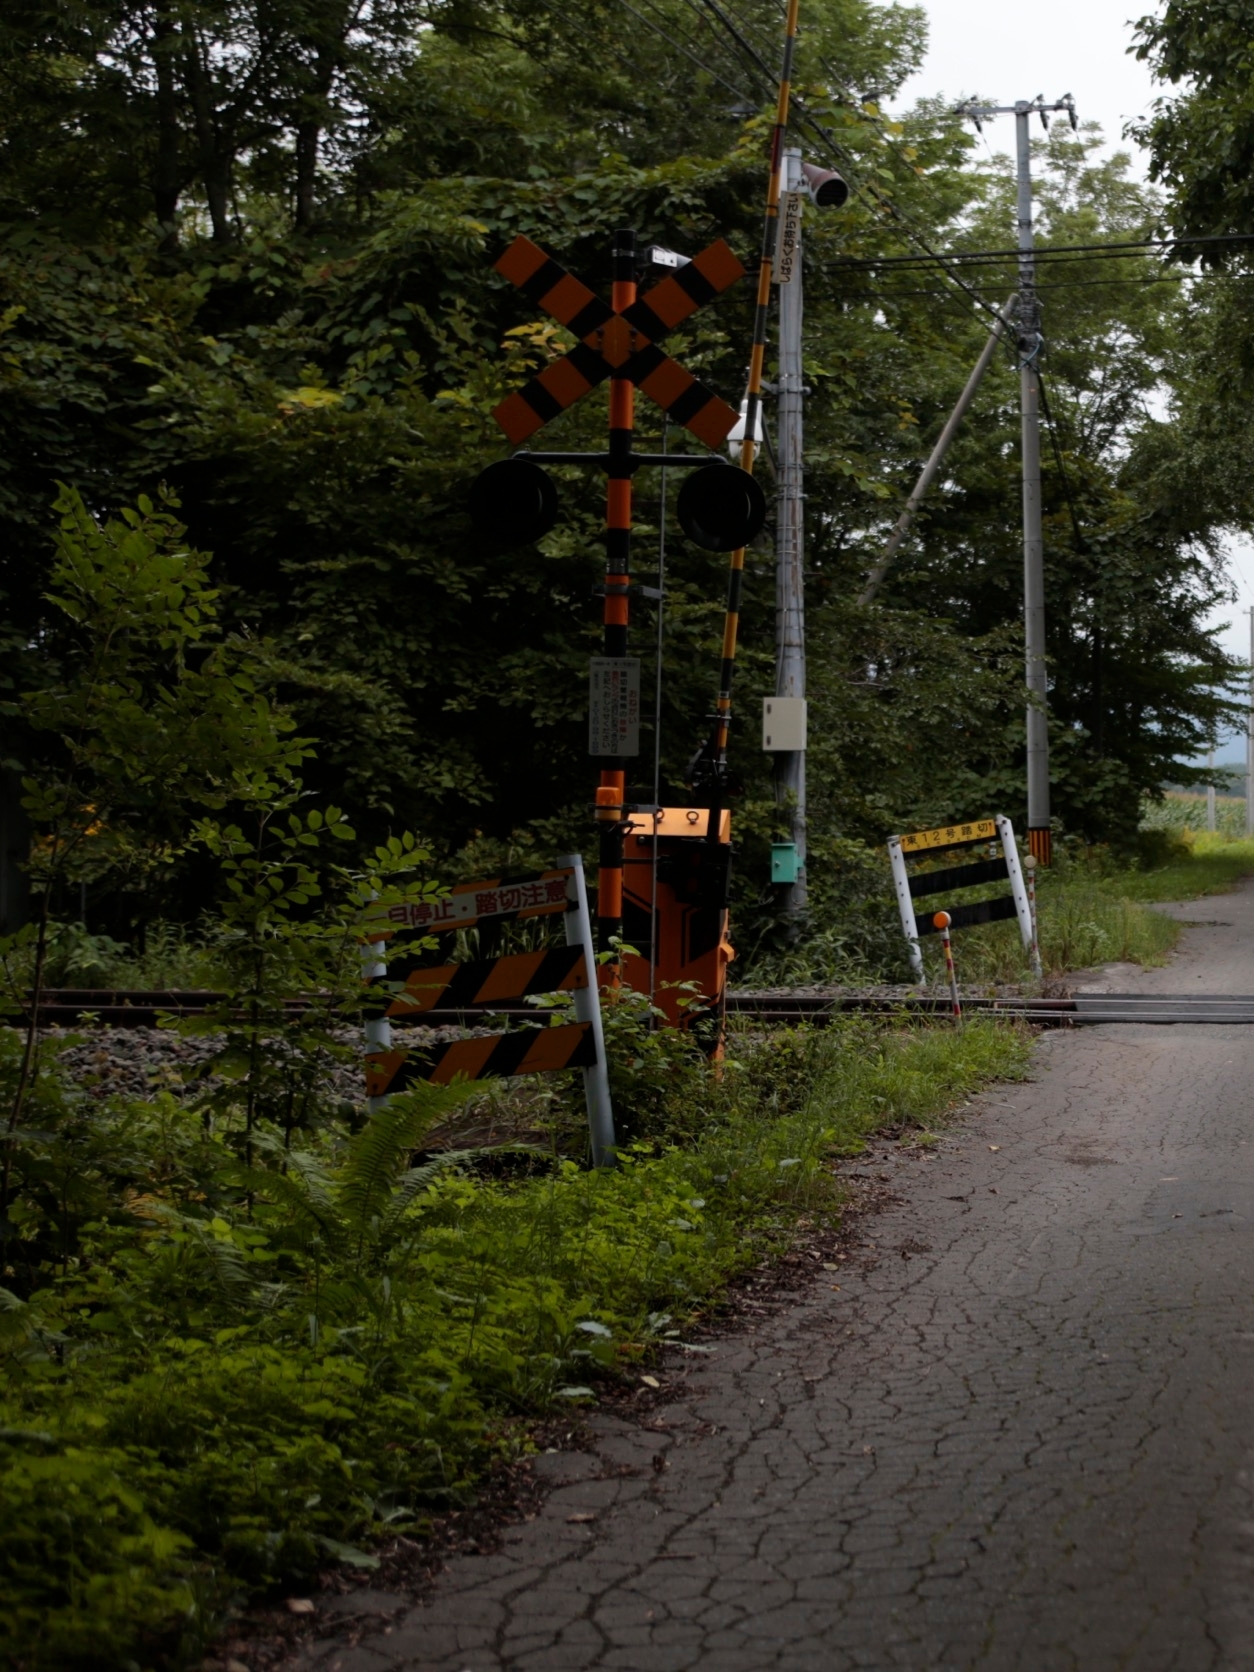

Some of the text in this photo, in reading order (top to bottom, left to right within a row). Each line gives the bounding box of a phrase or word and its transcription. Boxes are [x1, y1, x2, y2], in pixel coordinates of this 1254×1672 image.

[780, 193, 799, 283] しばらくお待ち下さい
